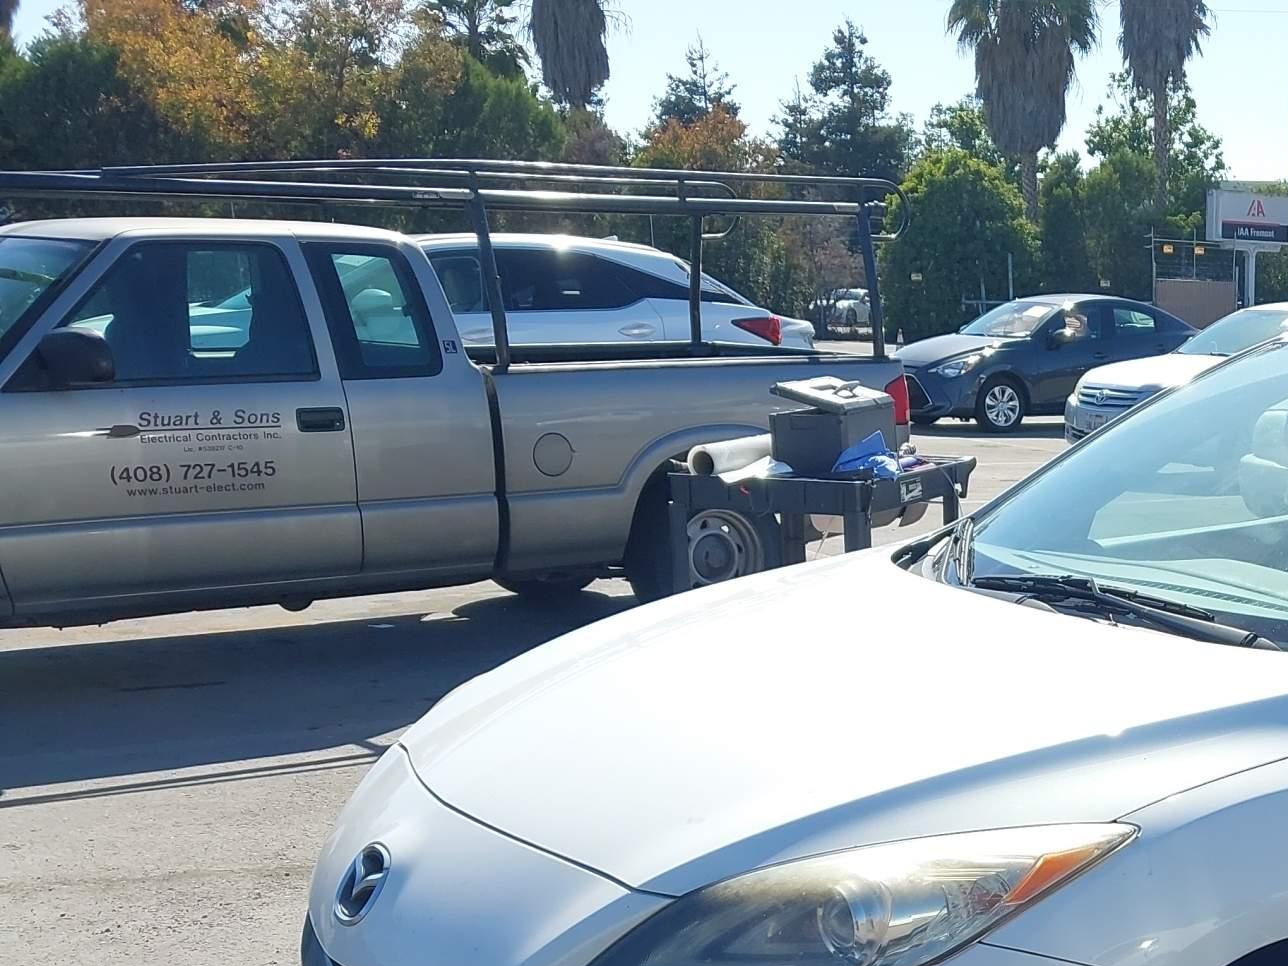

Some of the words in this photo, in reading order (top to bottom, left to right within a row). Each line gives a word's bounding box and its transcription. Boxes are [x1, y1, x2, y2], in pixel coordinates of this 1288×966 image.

[1237, 226, 1249, 237] IAA
[1250, 228, 1275, 239] Fremont
[138, 411, 200, 428] Stuart
[209, 410, 222, 425] &
[233, 408, 281, 425] Sons
[140, 434, 192, 444] Electrical
[195, 430, 259, 442] Contractors
[263, 431, 282, 440] Inc.
[110, 463, 171, 486] (408)
[179, 460, 277, 481] 727-1545
[126, 481, 265, 497] www.stuart-elect.com
